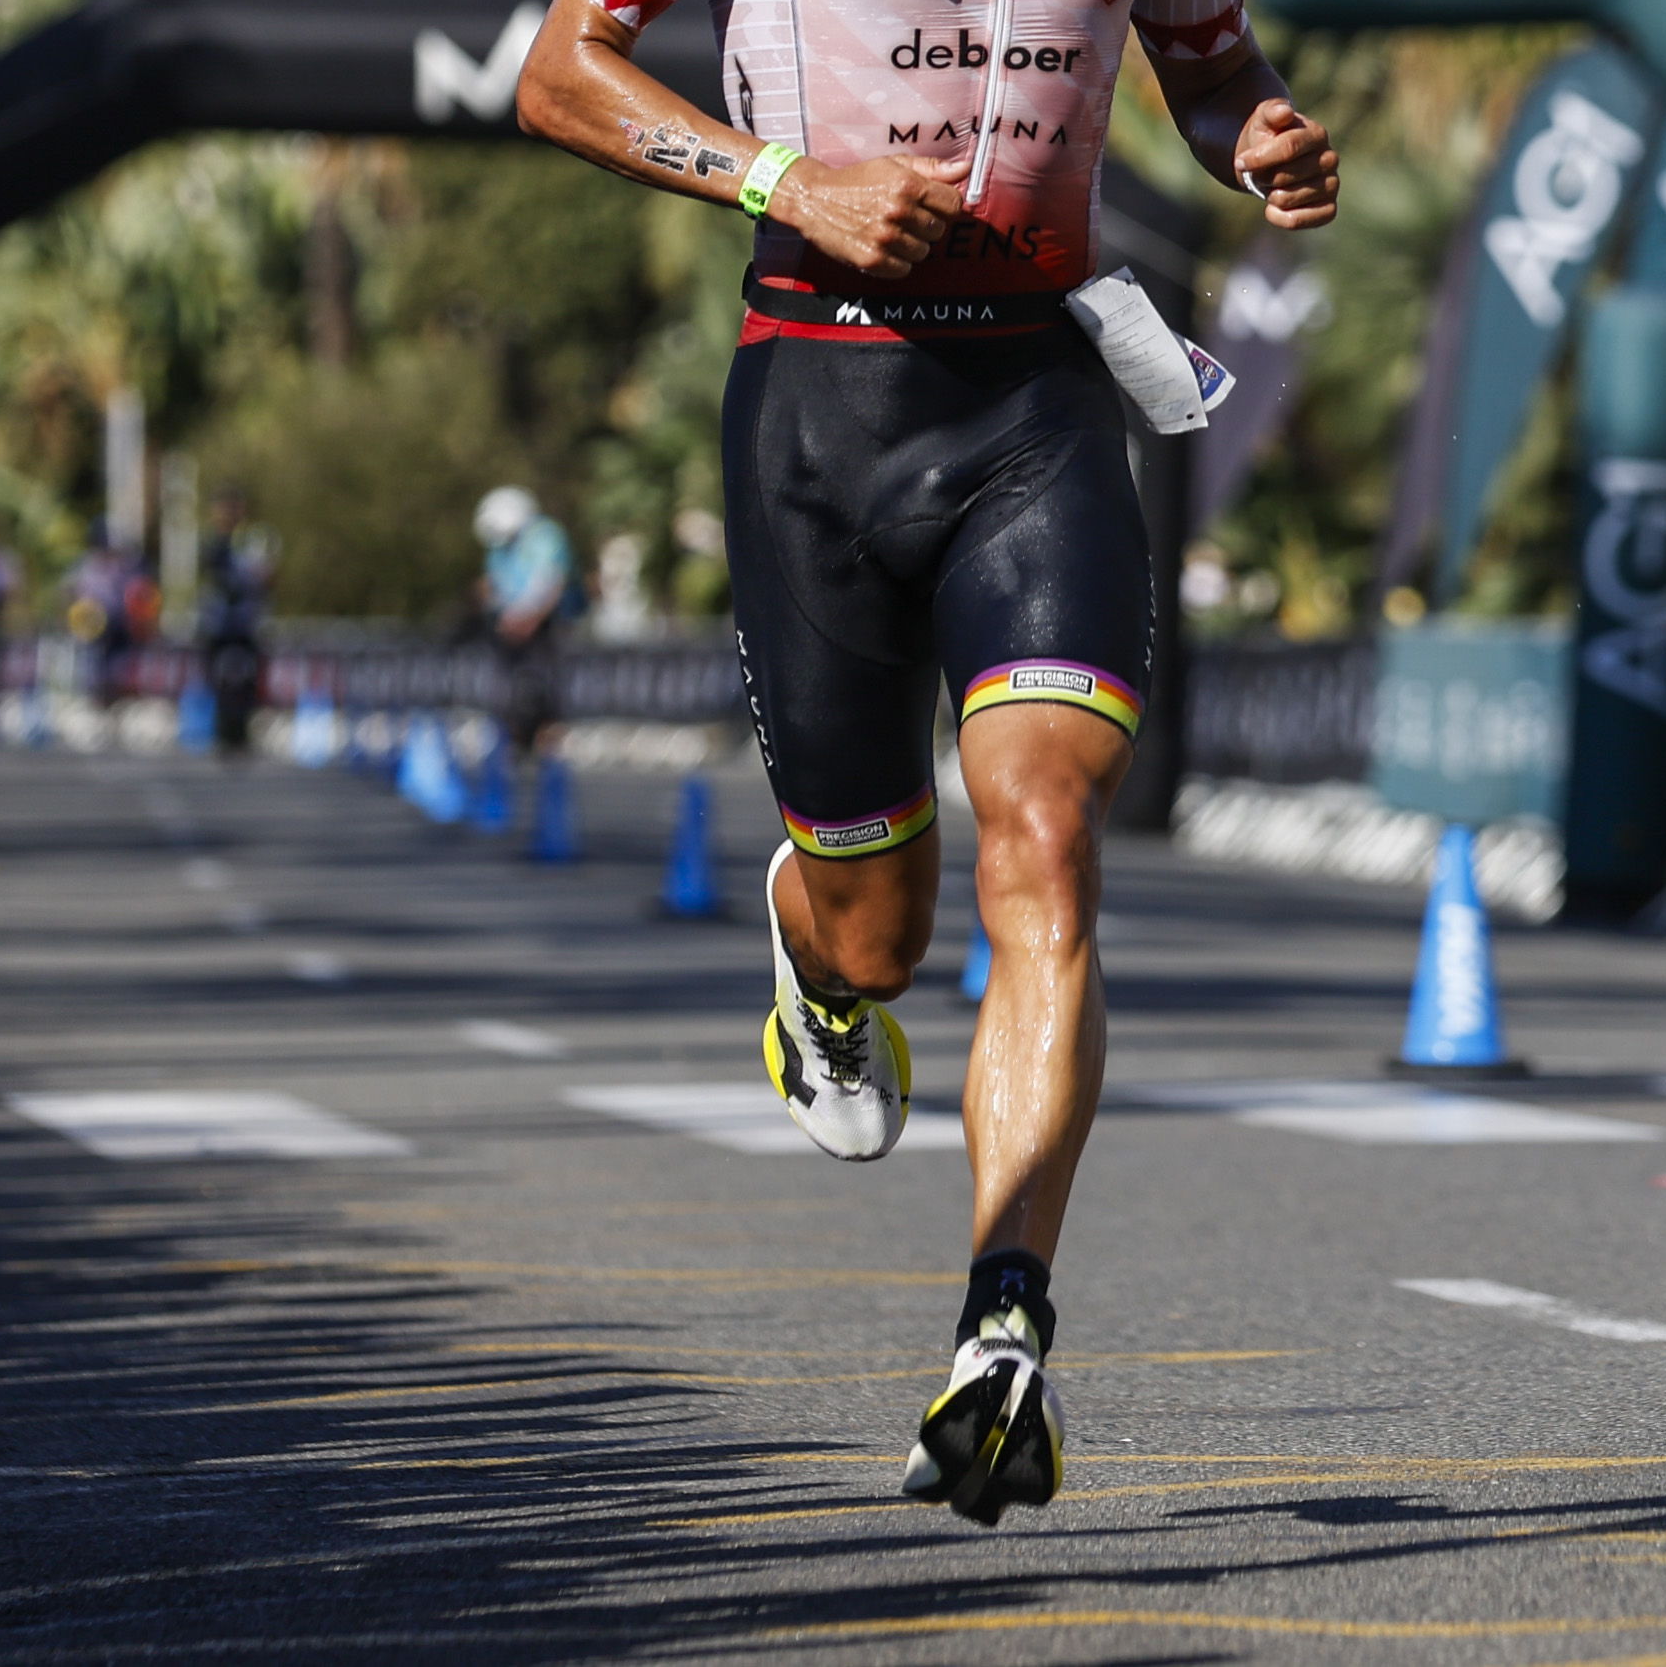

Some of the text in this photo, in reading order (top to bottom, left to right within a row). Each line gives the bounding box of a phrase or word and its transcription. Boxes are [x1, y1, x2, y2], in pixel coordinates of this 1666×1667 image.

[890, 27, 1083, 74] deboer
[888, 115, 1069, 146] MAUNA
[883, 304, 995, 321] MAUNA
[1016, 670, 1090, 687] PRECISION
[818, 822, 883, 841] PRECISION
